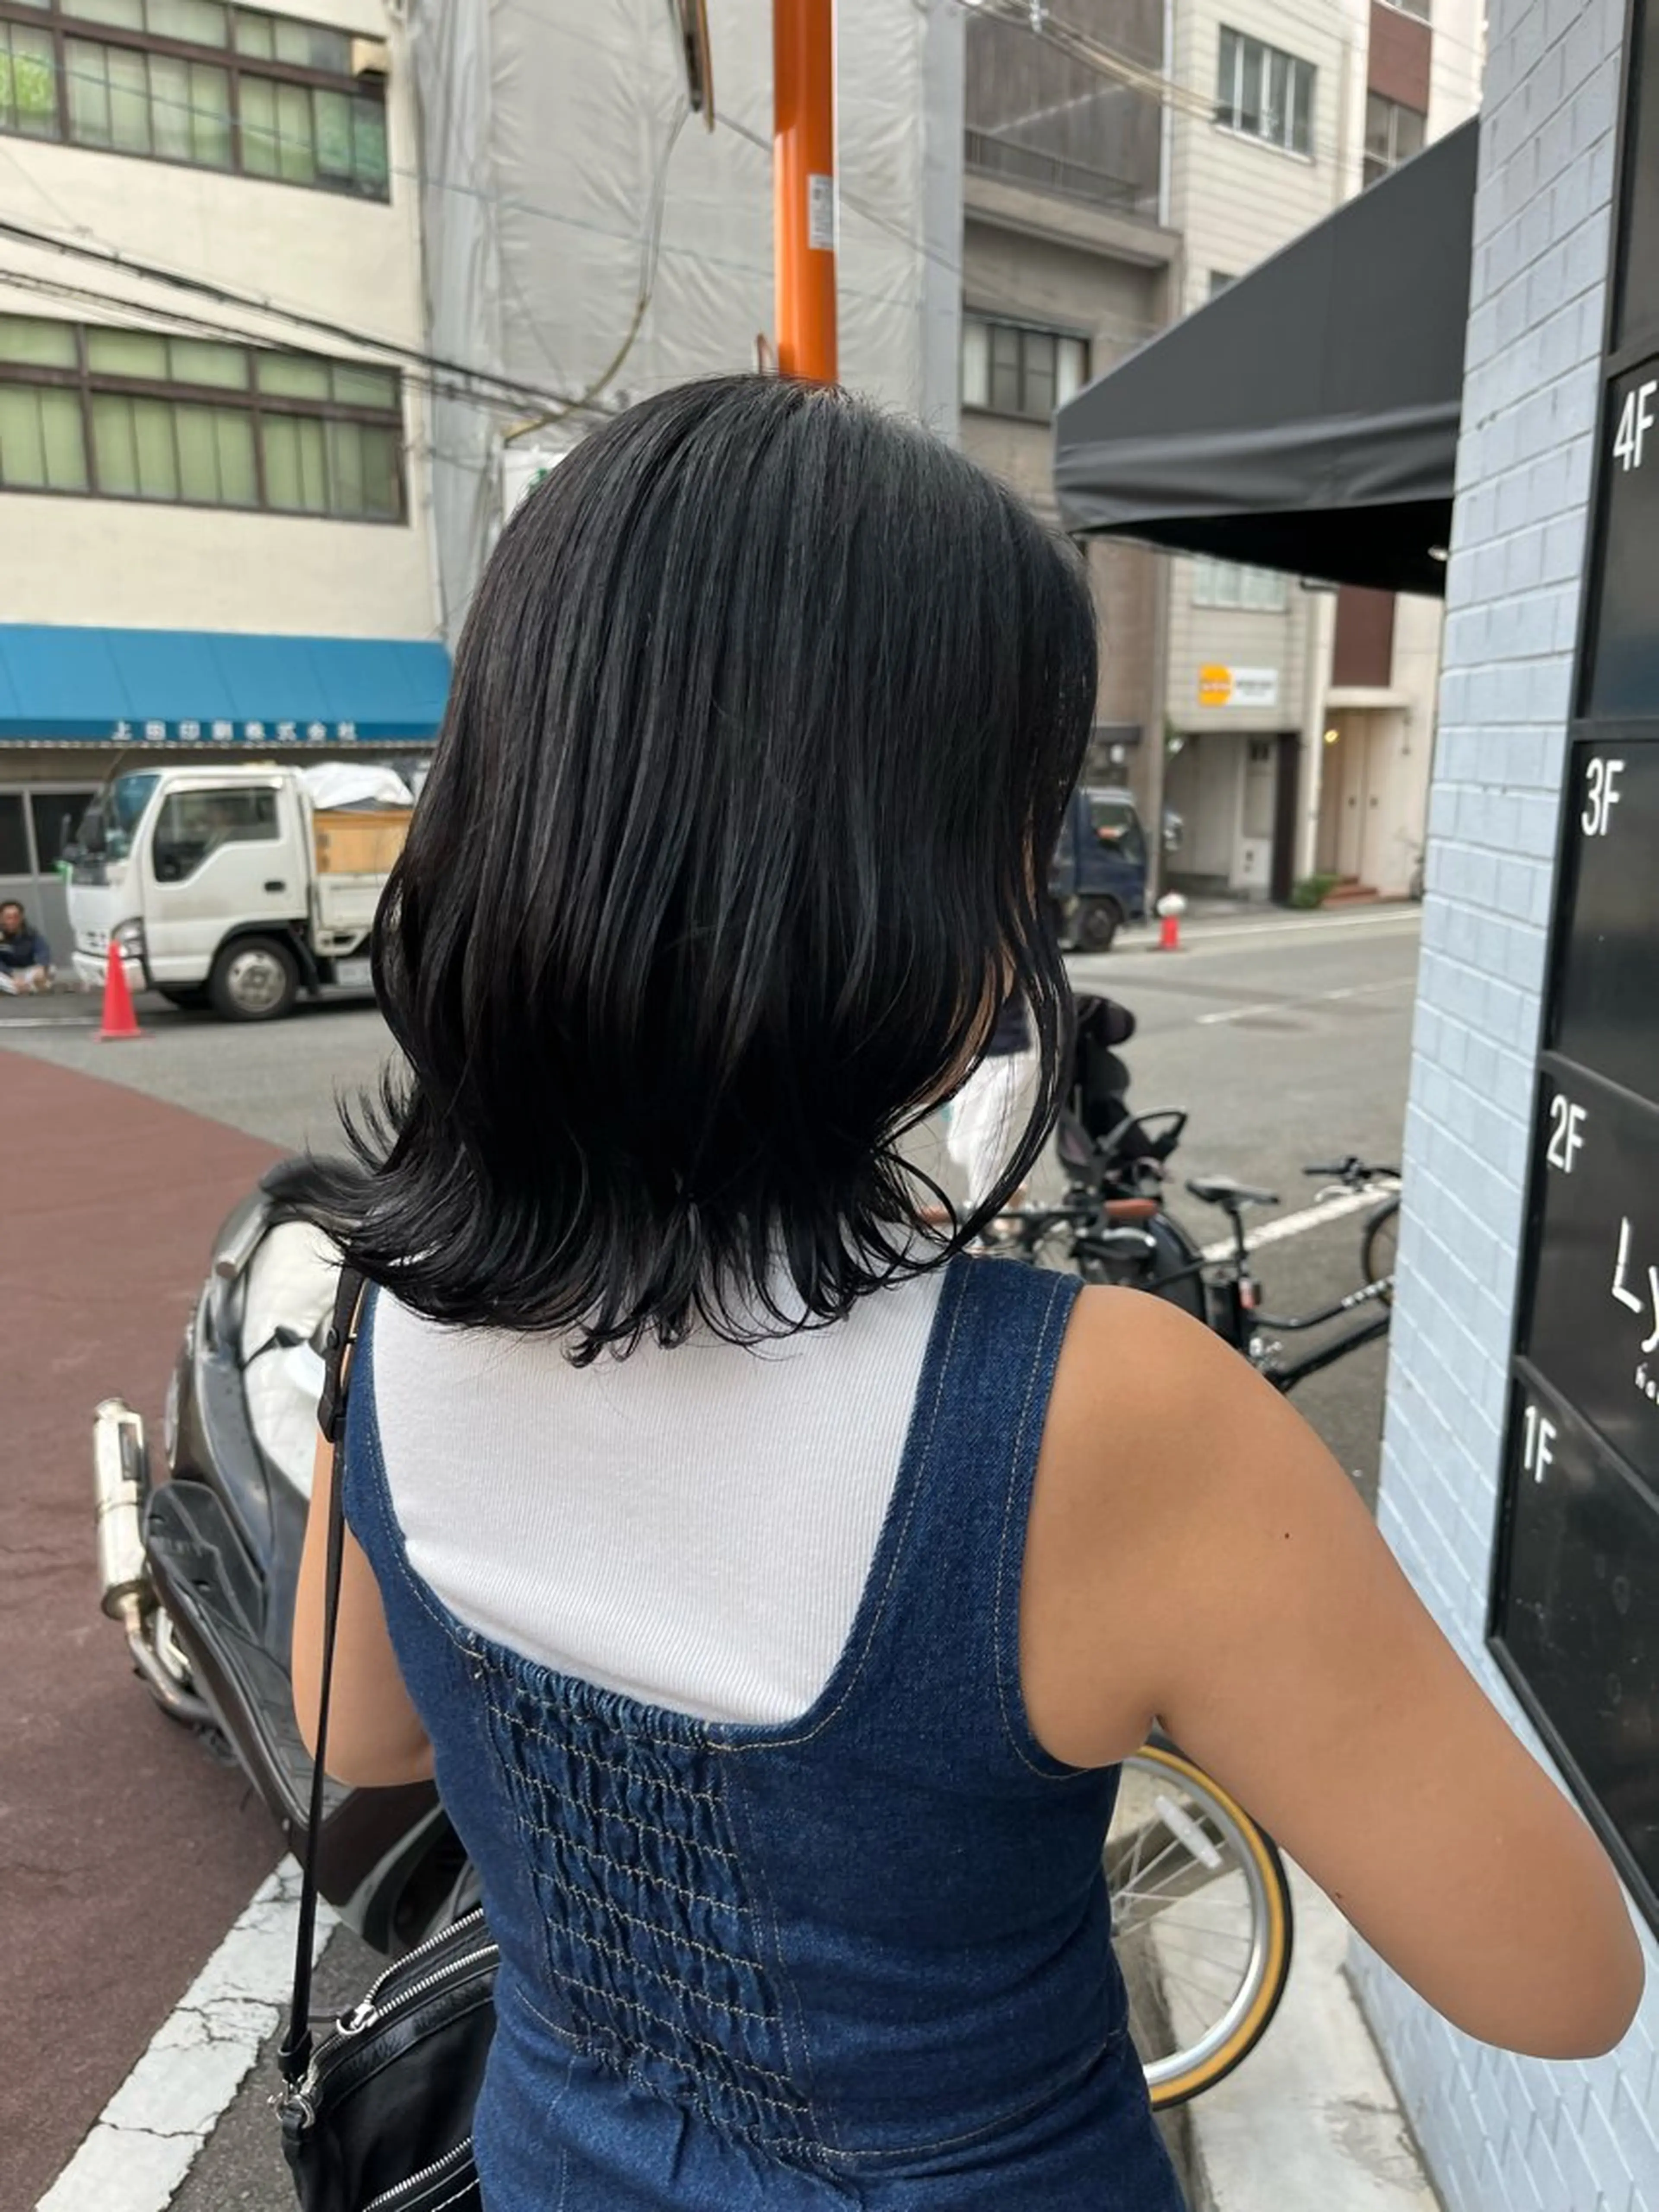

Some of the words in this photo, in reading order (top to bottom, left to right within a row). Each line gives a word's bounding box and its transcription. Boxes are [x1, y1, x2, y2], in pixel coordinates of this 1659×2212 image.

[1612, 380, 1658, 472] 4F
[1581, 757, 1625, 836] 3F
[1546, 1094, 1588, 1173] 2F
[1524, 1405, 1557, 1483] 1F
